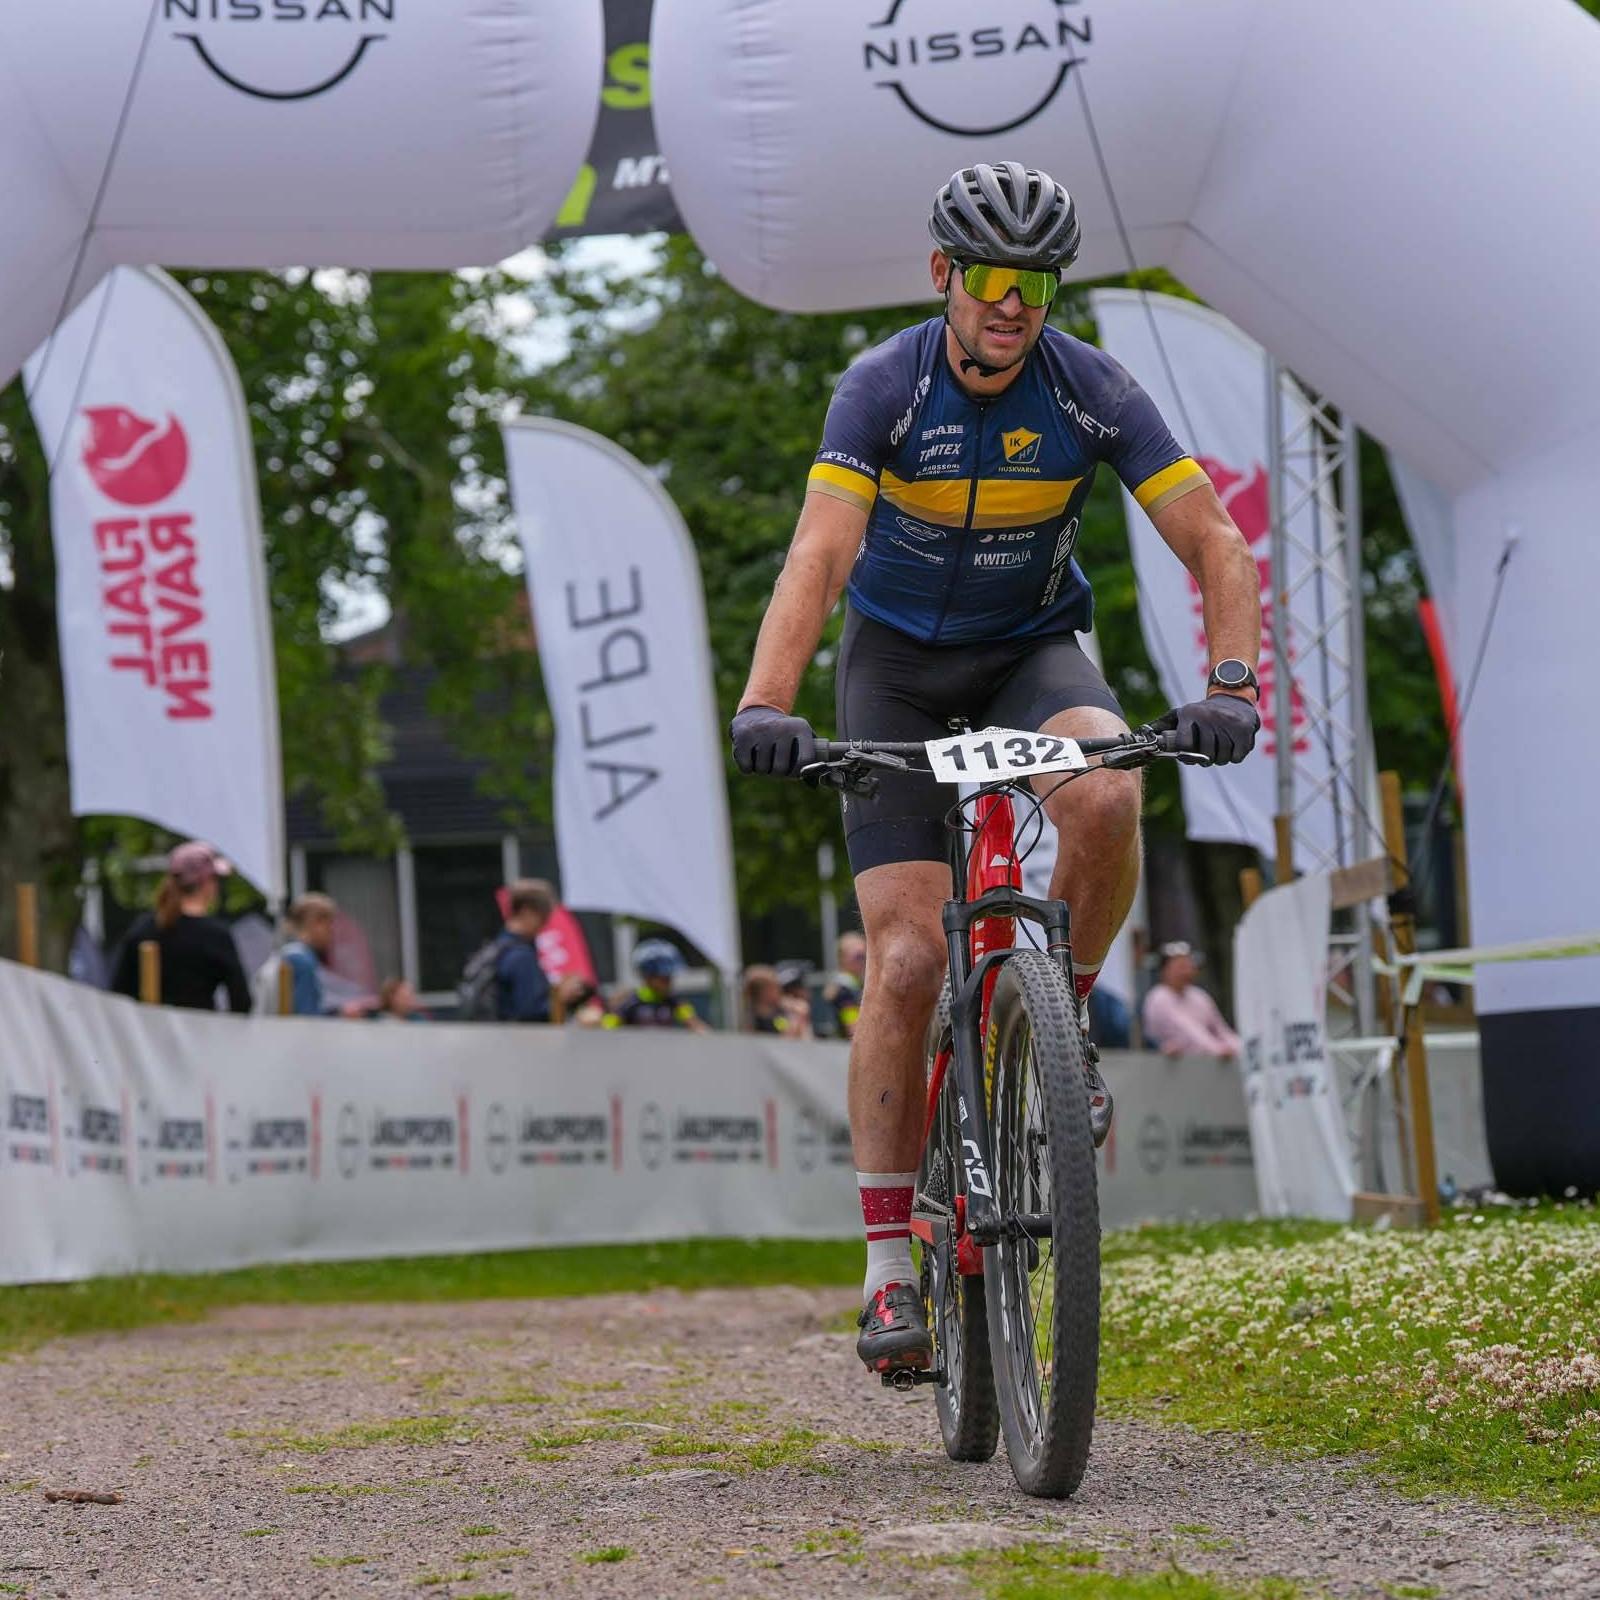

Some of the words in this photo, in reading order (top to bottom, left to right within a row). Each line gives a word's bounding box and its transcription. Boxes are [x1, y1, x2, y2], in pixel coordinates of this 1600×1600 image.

[164, 0, 396, 20] NISSAN
[862, 15, 1093, 70] NISSAN
[1009, 438, 1022, 447] IK
[998, 466, 1041, 474] HUSKVARNA
[998, 531, 1036, 541] REDO
[942, 737, 1070, 772] 1132
